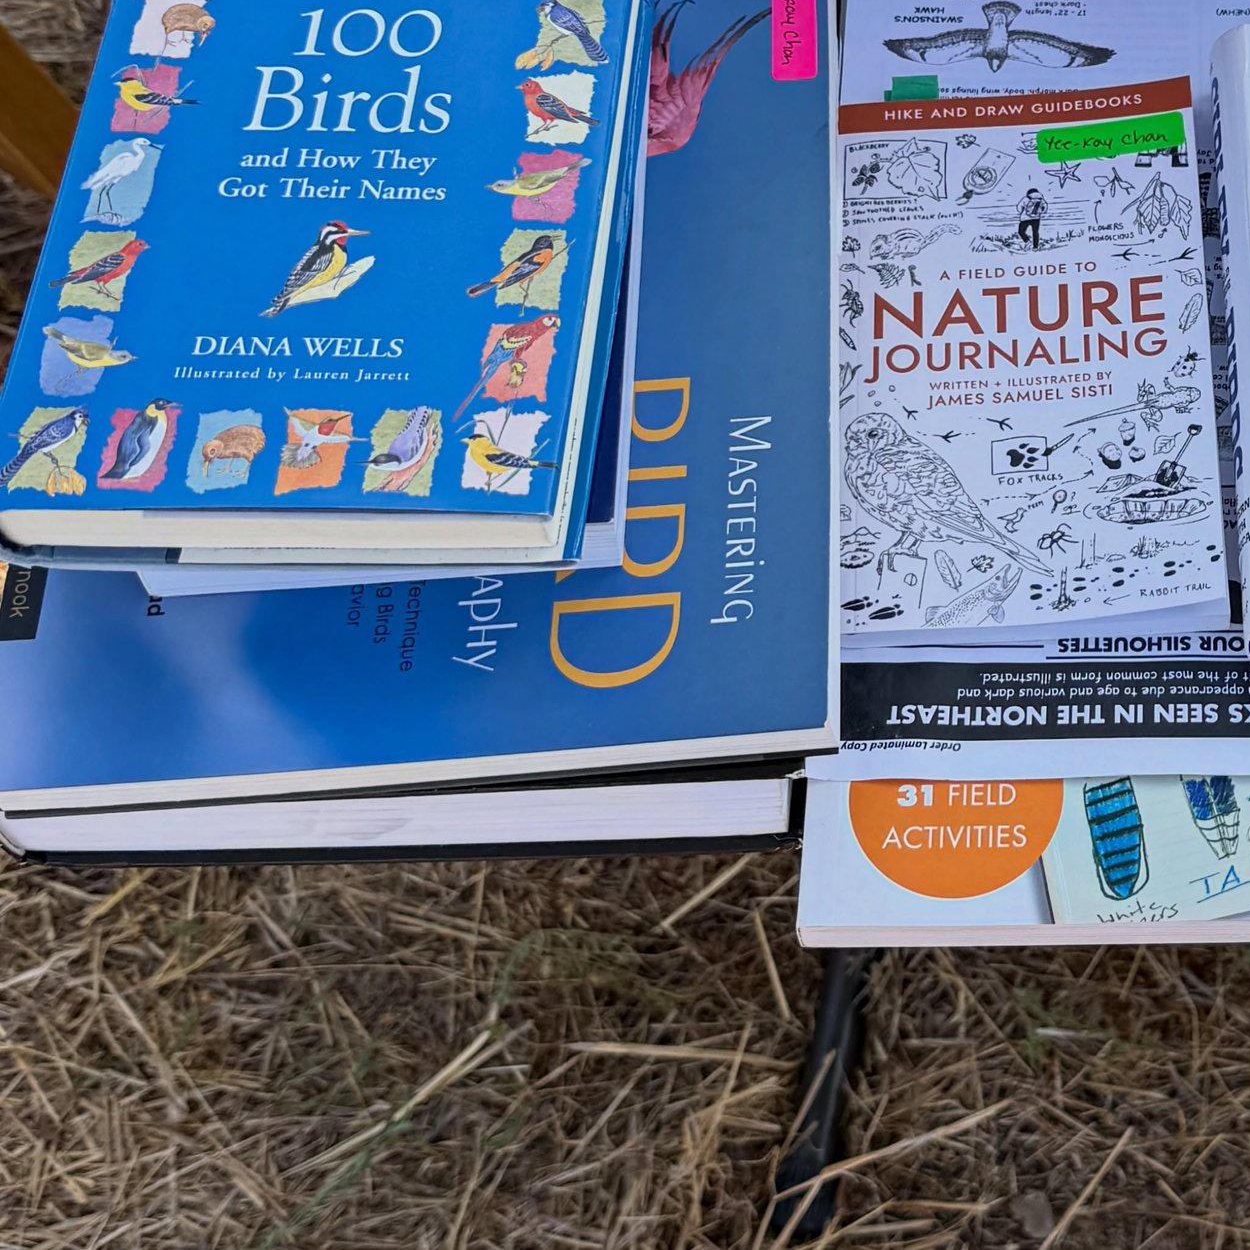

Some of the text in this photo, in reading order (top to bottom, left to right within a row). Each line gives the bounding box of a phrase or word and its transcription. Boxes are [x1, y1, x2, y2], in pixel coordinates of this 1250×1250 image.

[293, 8, 444, 59] 100
[242, 66, 453, 135] Birds
[885, 94, 1143, 121] HIKE AND DRAW GUIDEBOOKS
[240, 149, 437, 176] and How They
[217, 176, 446, 201] Got Their Names
[939, 262, 1097, 281] A FIELD GUIDE TO
[872, 275, 1165, 340] NATURE
[191, 336, 404, 358] DIANA WELLS
[864, 327, 1168, 383] JOURNALING
[173, 366, 410, 383] Illustrated by Lauren Jarrett
[927, 384, 1113, 410] JAMES SAMUEL SISTI
[998, 473, 1063, 486] FOX TRACKS
[373, 604, 391, 646] Birds
[1058, 636, 1191, 653] SILHOUETTES
[887, 704, 1047, 724] NORTHEAST
[1058, 704, 1105, 724] THE
[1114, 704, 1143, 723] IN
[1154, 704, 1218, 723] SEEN
[897, 783, 1017, 807] 31 FIELD
[881, 824, 1027, 849] ACTIVITIES
